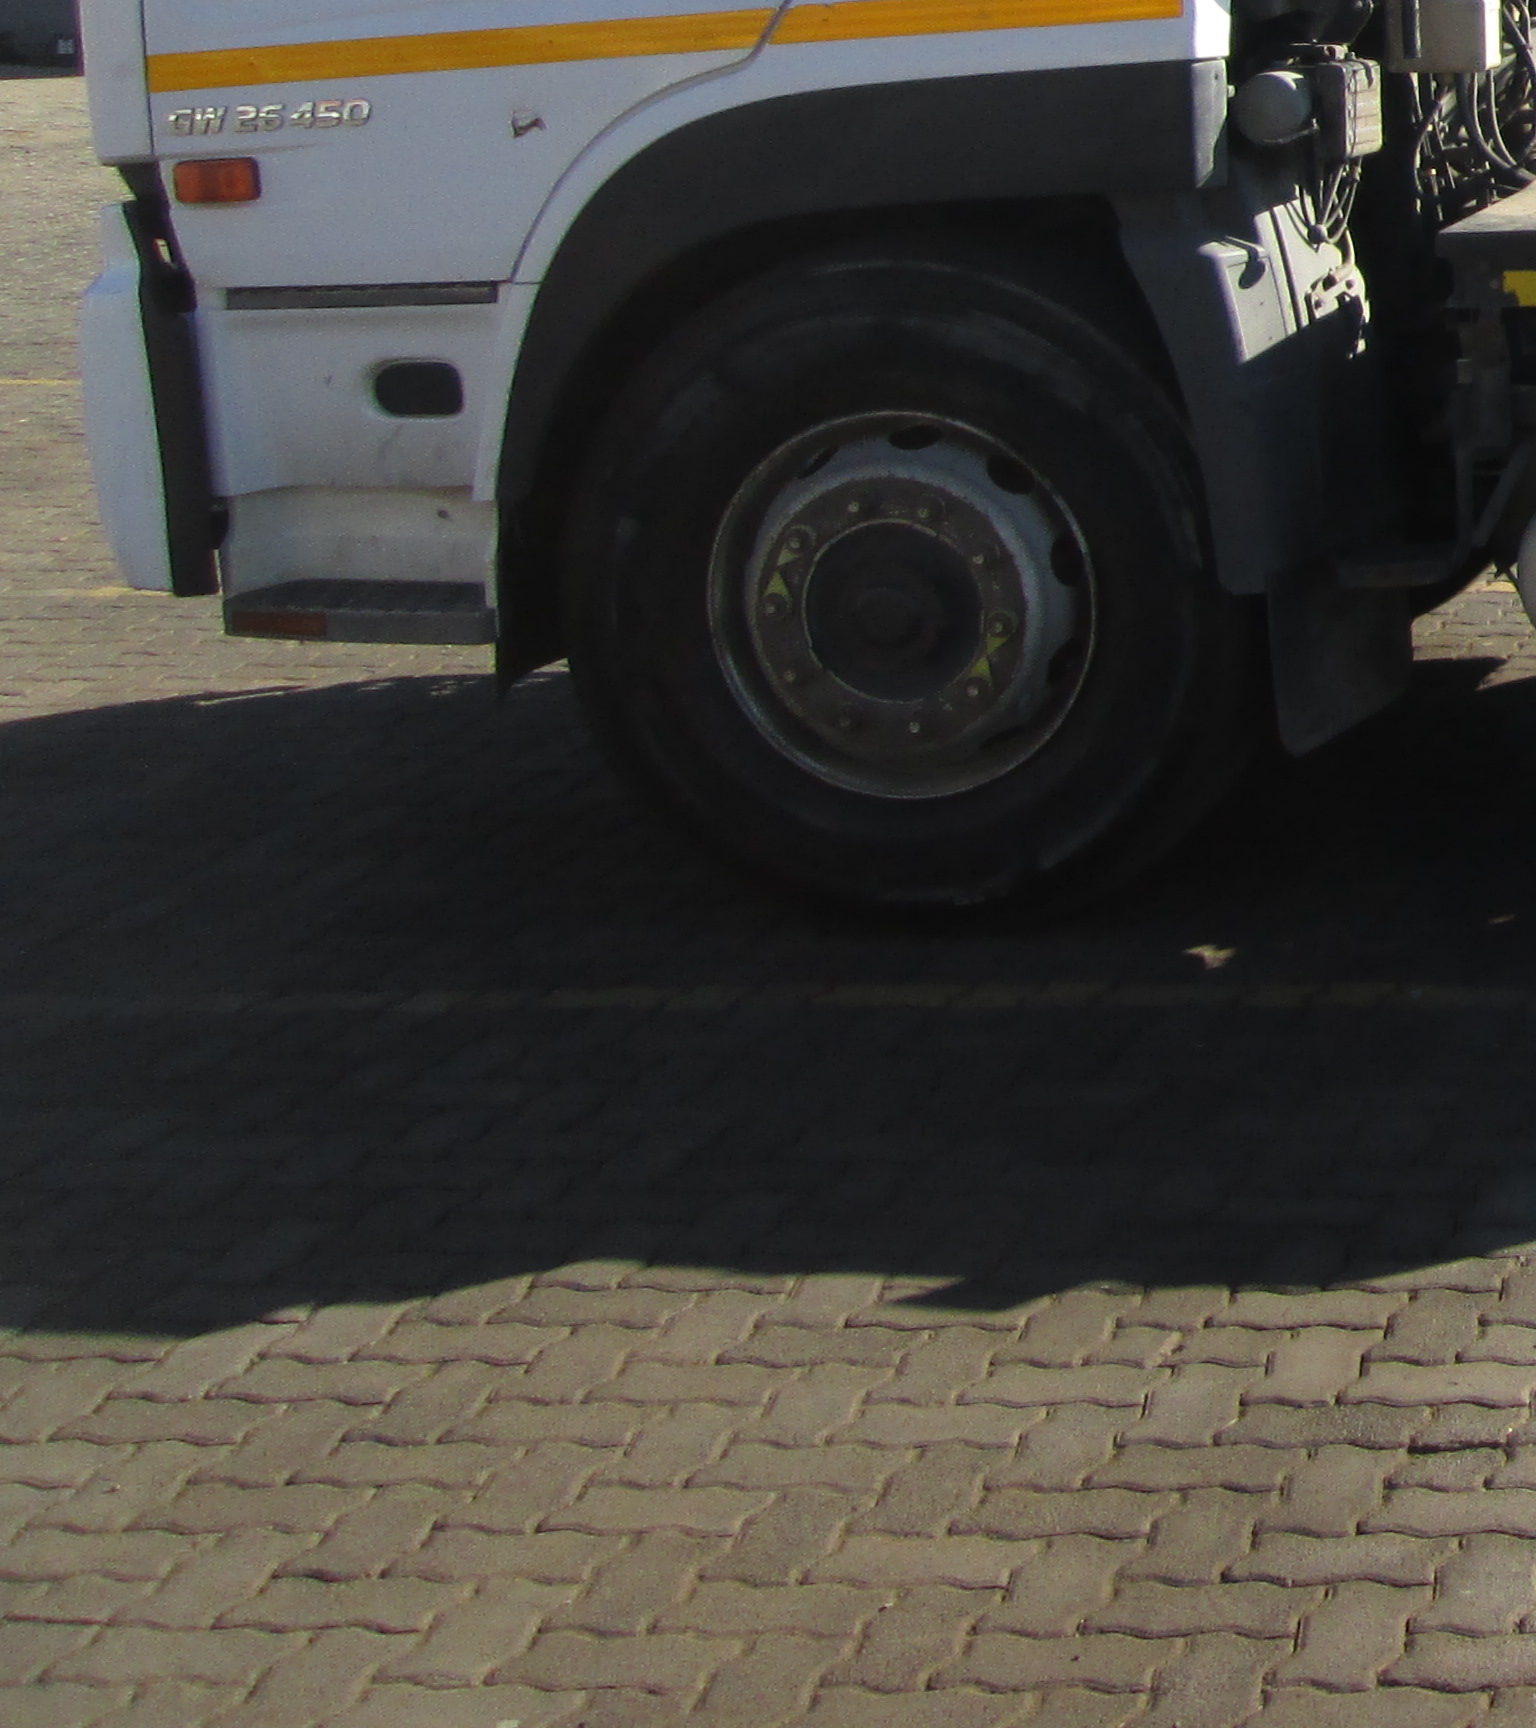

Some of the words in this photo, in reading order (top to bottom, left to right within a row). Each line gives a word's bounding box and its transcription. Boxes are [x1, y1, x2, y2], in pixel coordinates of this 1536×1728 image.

[168, 105, 227, 136] GW
[234, 103, 284, 133] 26
[290, 98, 372, 129] 450
